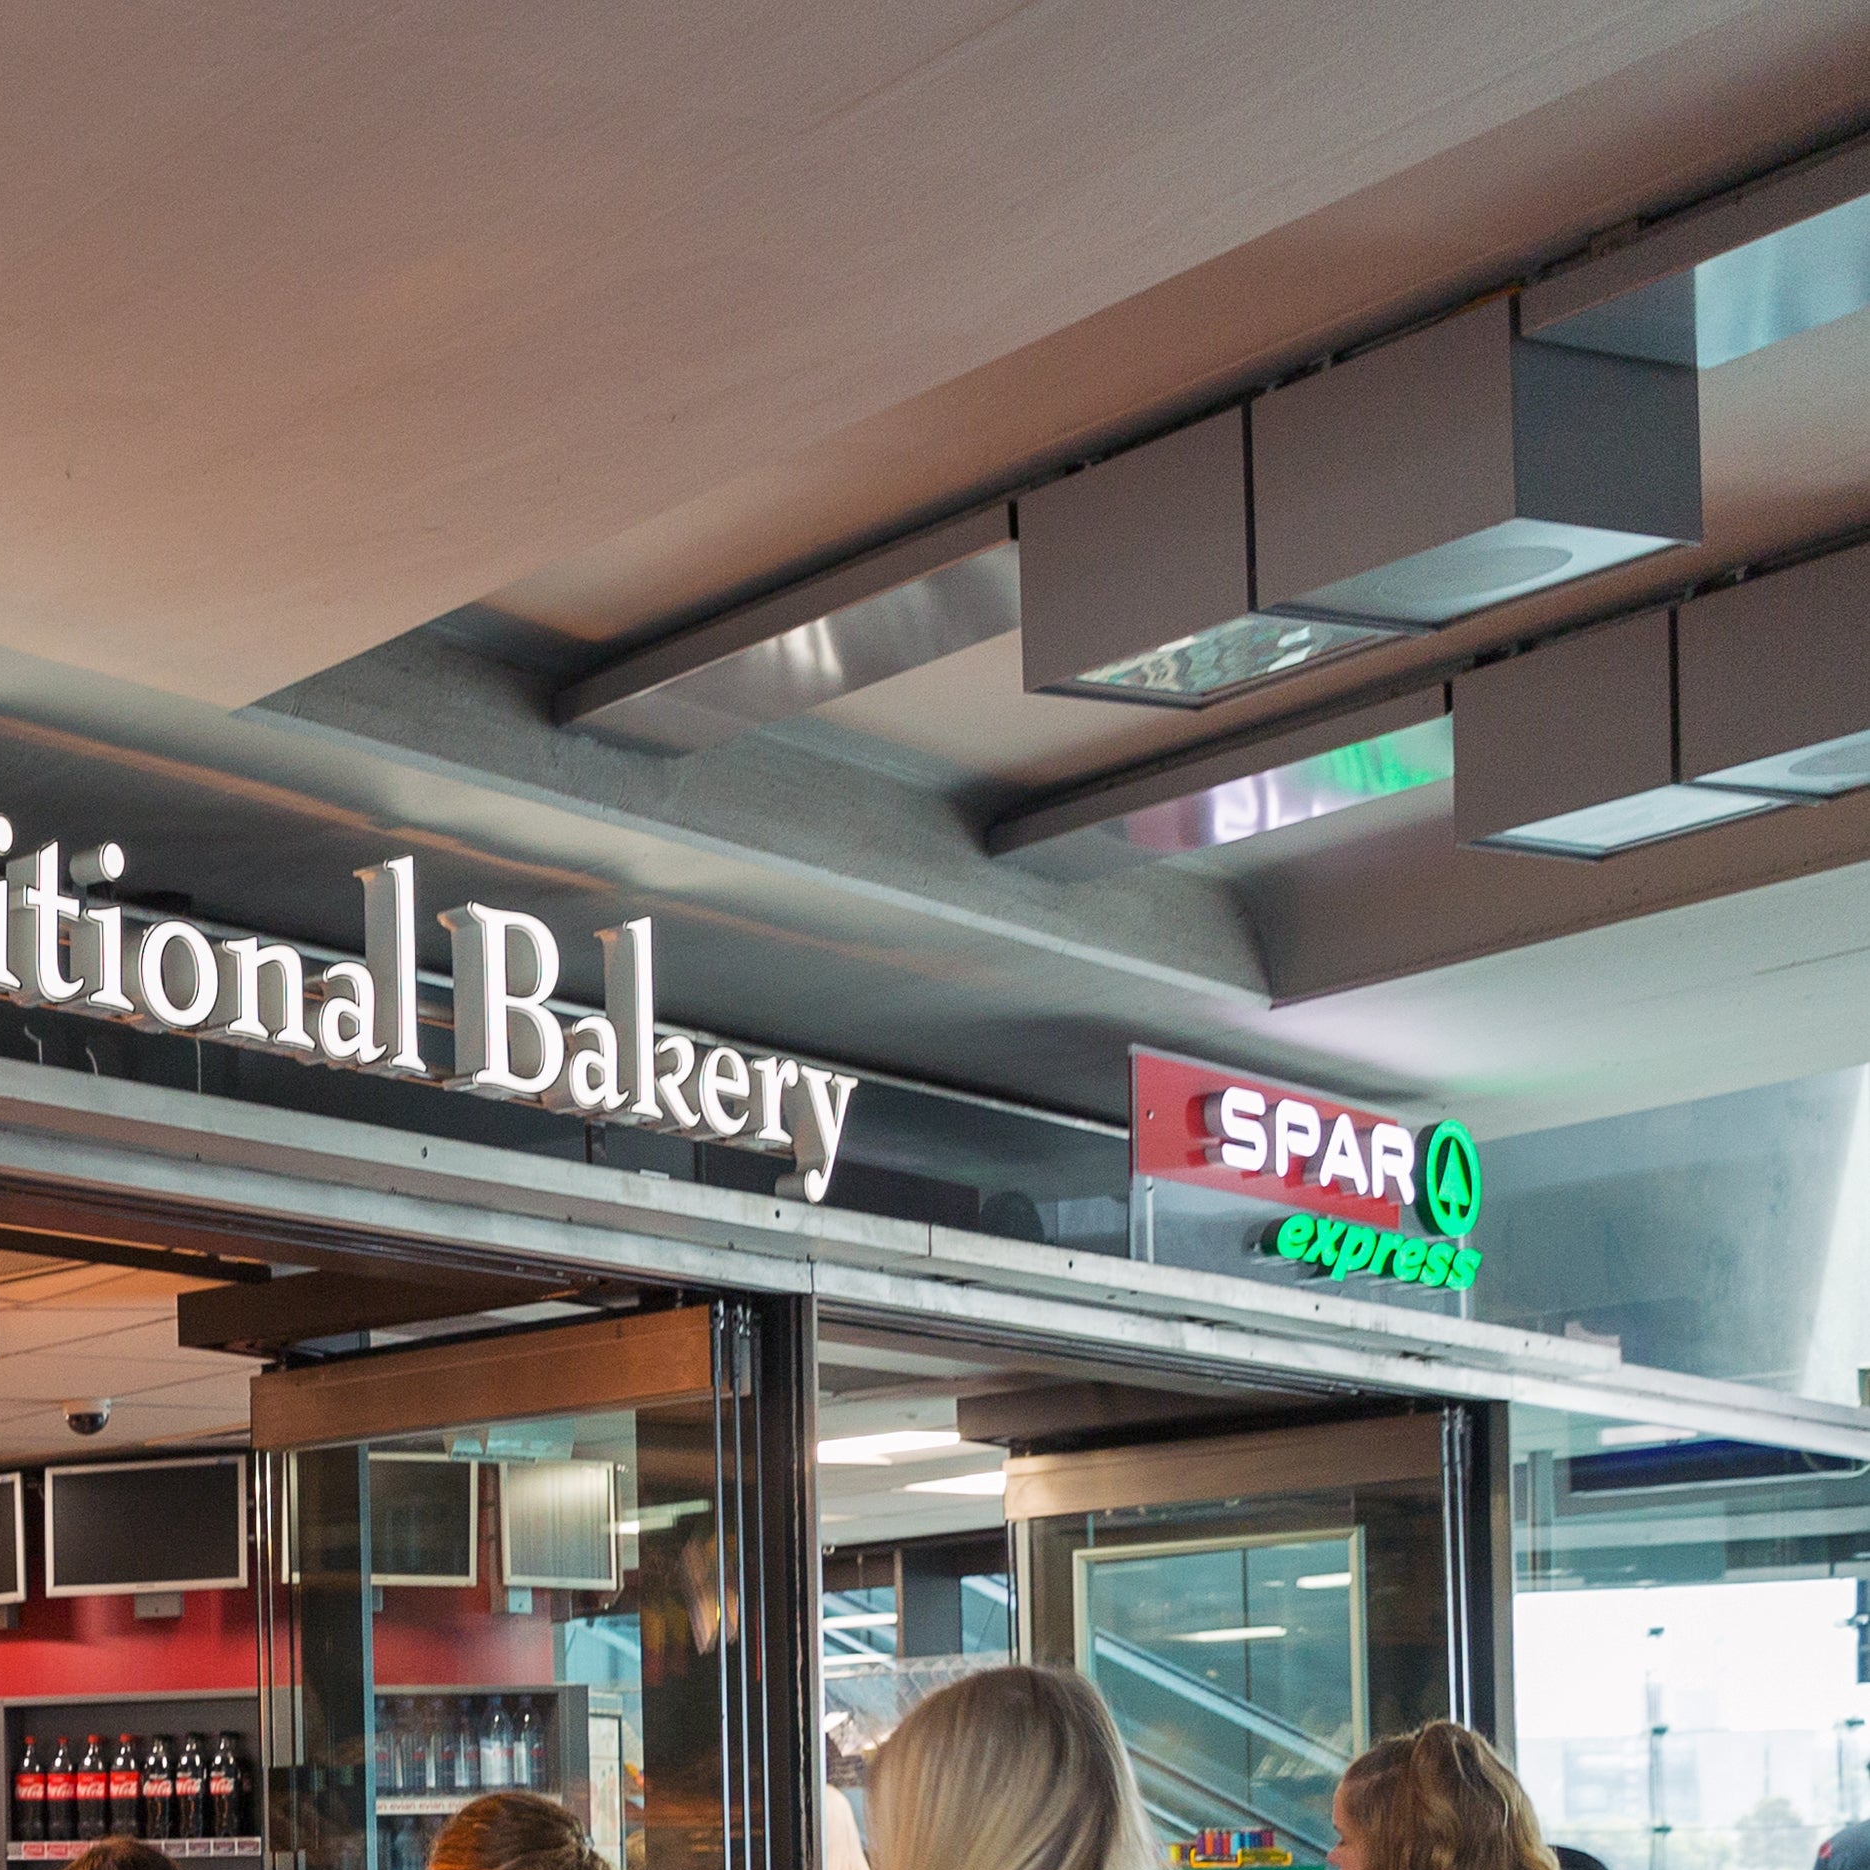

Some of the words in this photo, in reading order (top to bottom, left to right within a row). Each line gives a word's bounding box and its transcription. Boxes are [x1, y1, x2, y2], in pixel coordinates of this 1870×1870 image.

[460, 898, 859, 1203] Bakery
[1215, 1085, 1416, 1206] SPAR
[1276, 1212, 1482, 1292] express
